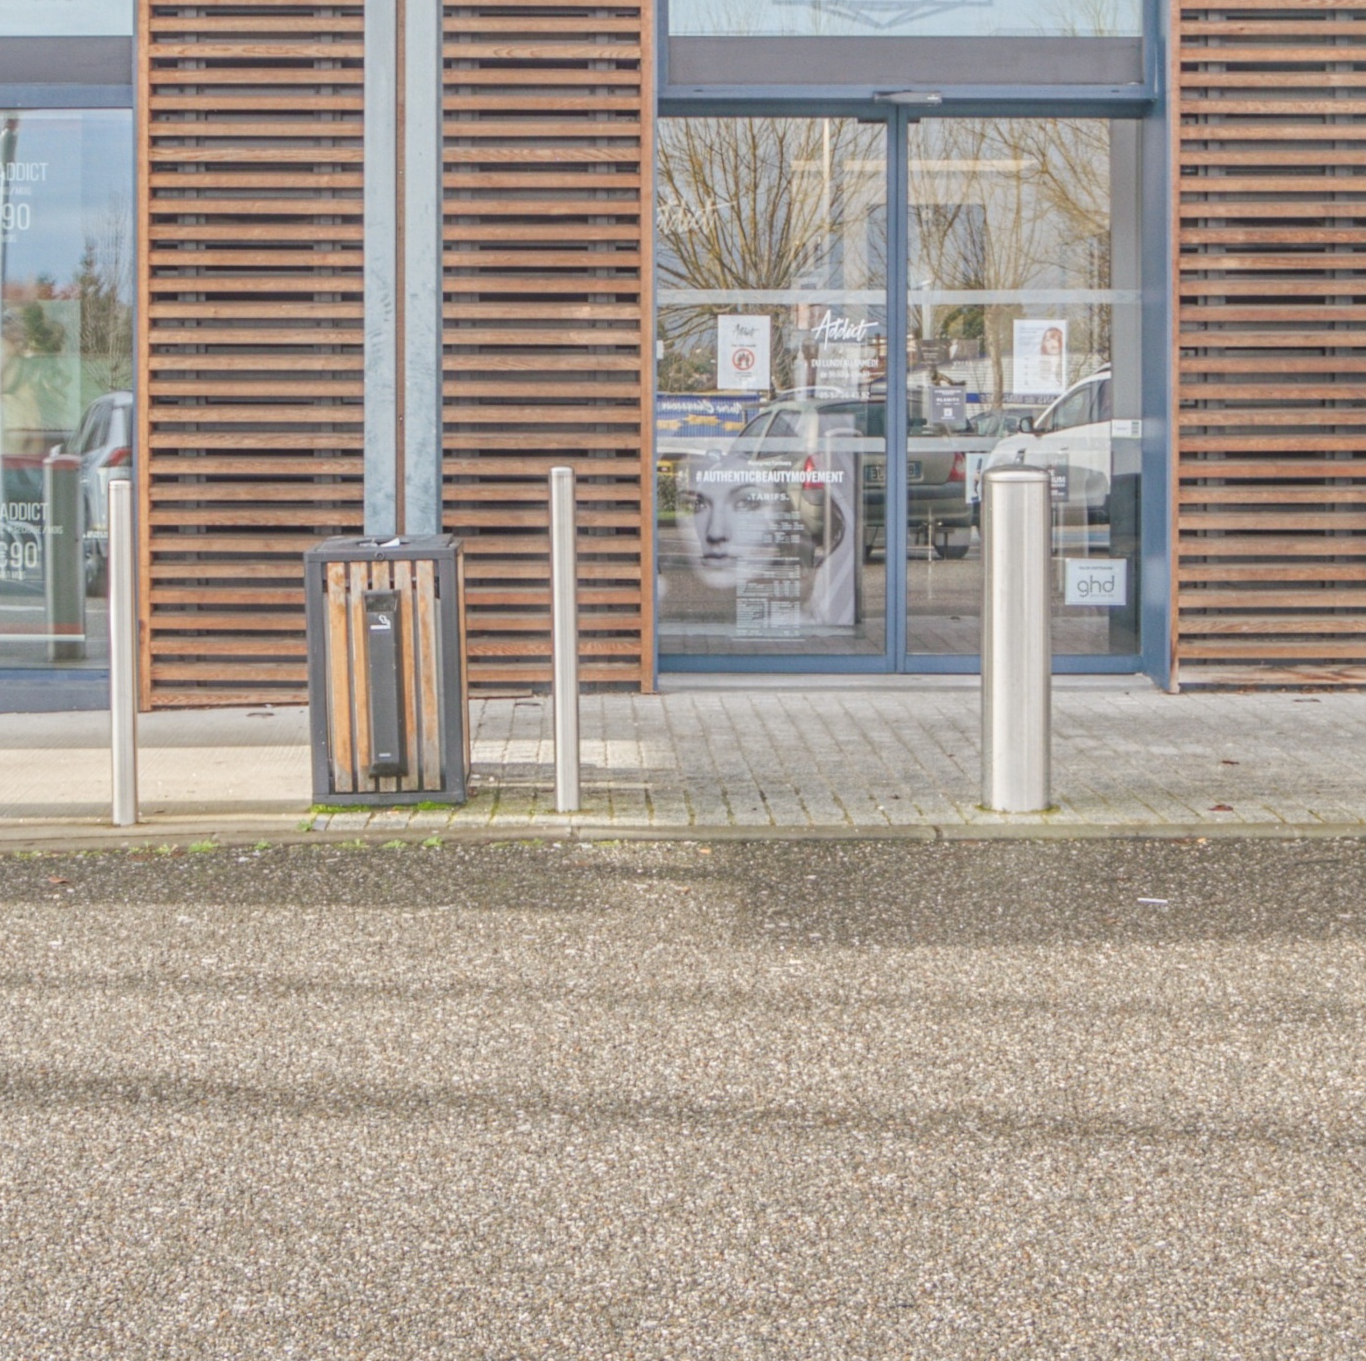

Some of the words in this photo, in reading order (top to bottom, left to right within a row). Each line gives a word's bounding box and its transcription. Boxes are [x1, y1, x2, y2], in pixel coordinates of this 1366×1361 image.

[811, 309, 879, 351] Addict
[696, 470, 845, 484] #AUTHENTICBEAUTYMOVEMENT
[0, 502, 48, 521] ADDICT
[1077, 575, 1115, 598] ghd
